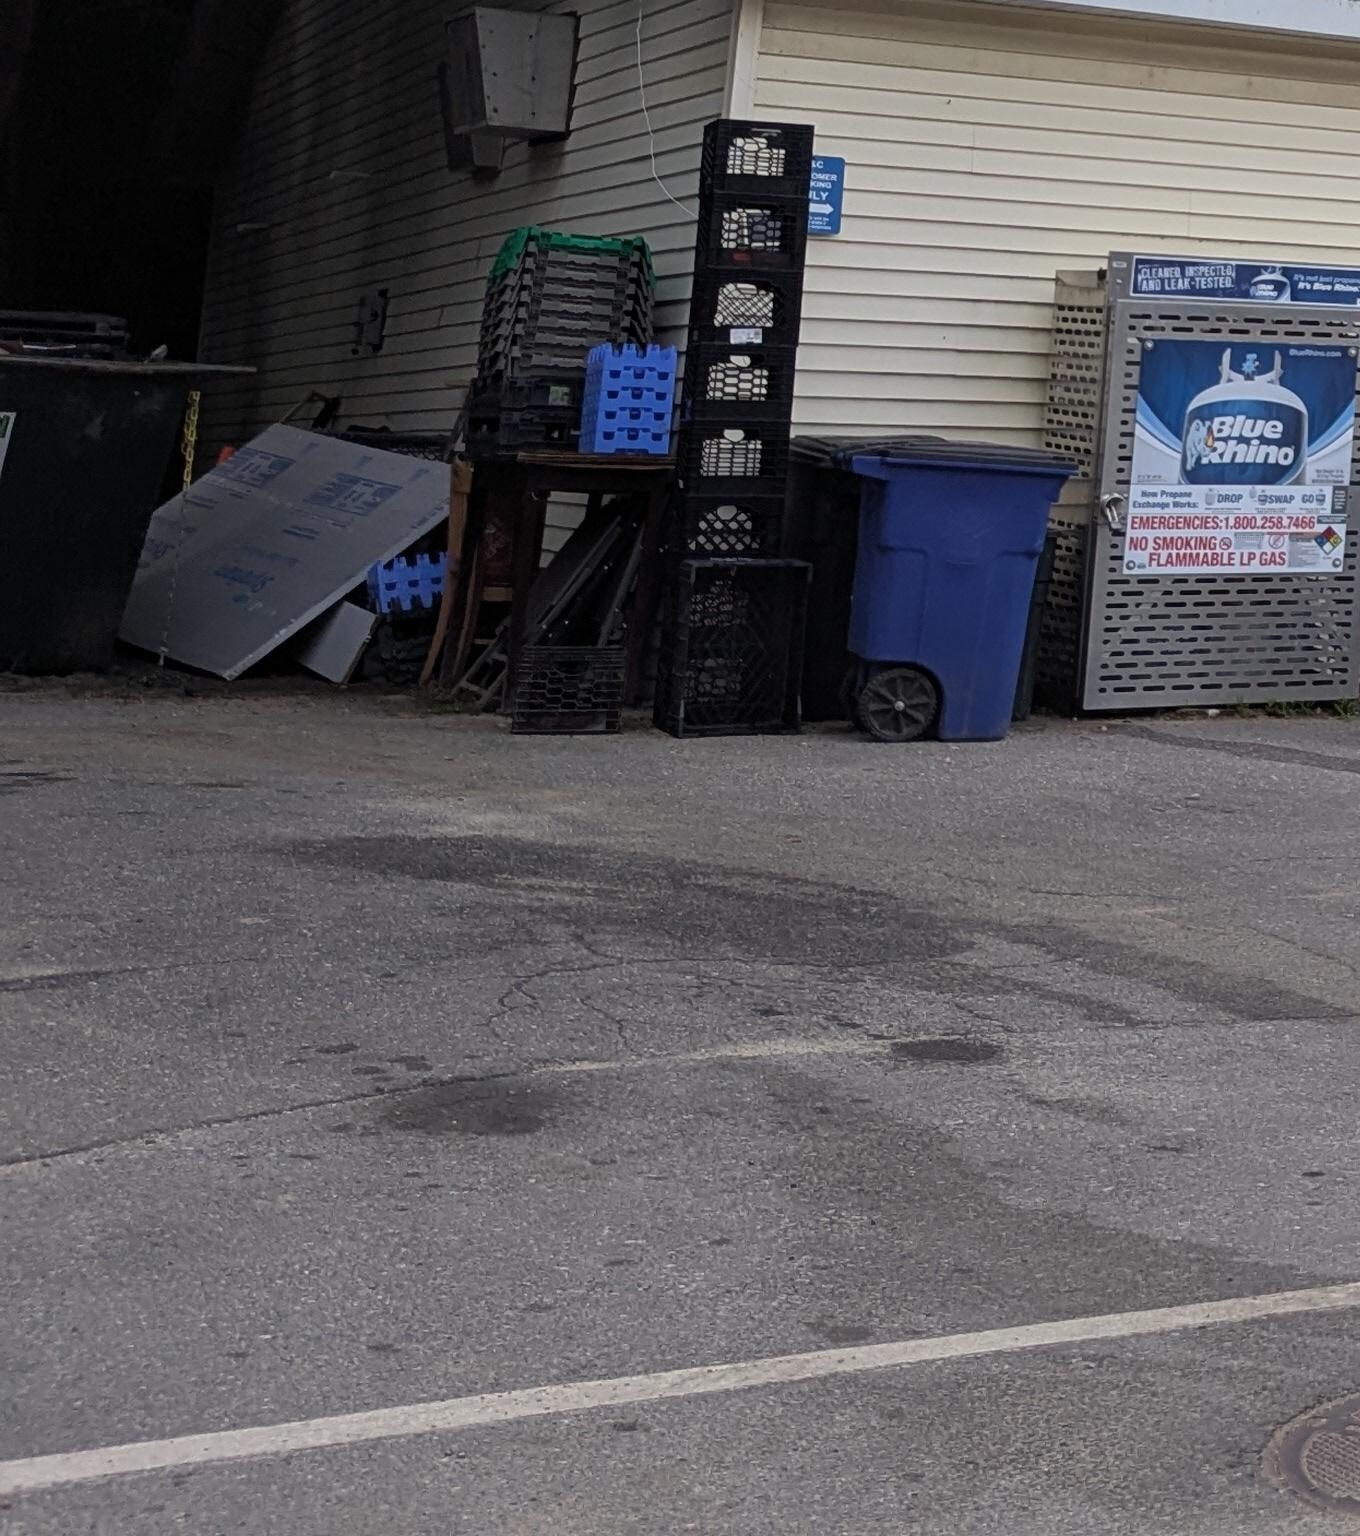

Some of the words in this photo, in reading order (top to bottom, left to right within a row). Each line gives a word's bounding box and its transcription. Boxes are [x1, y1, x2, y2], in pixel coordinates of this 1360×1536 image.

[1141, 279, 1162, 292] AND
[1213, 414, 1284, 440] Blue
[1200, 439, 1295, 466] Rhino
[1160, 489, 1193, 500] Propane
[1216, 493, 1244, 504] DROP
[1267, 494, 1296, 505] SWAP
[1301, 493, 1315, 504] GO
[1128, 536, 1149, 551] NO
[1151, 536, 1217, 551] SMOKING
[1147, 551, 1237, 568] FLAMMABLE
[1239, 551, 1256, 567] LP
[1258, 551, 1287, 567] GAS
